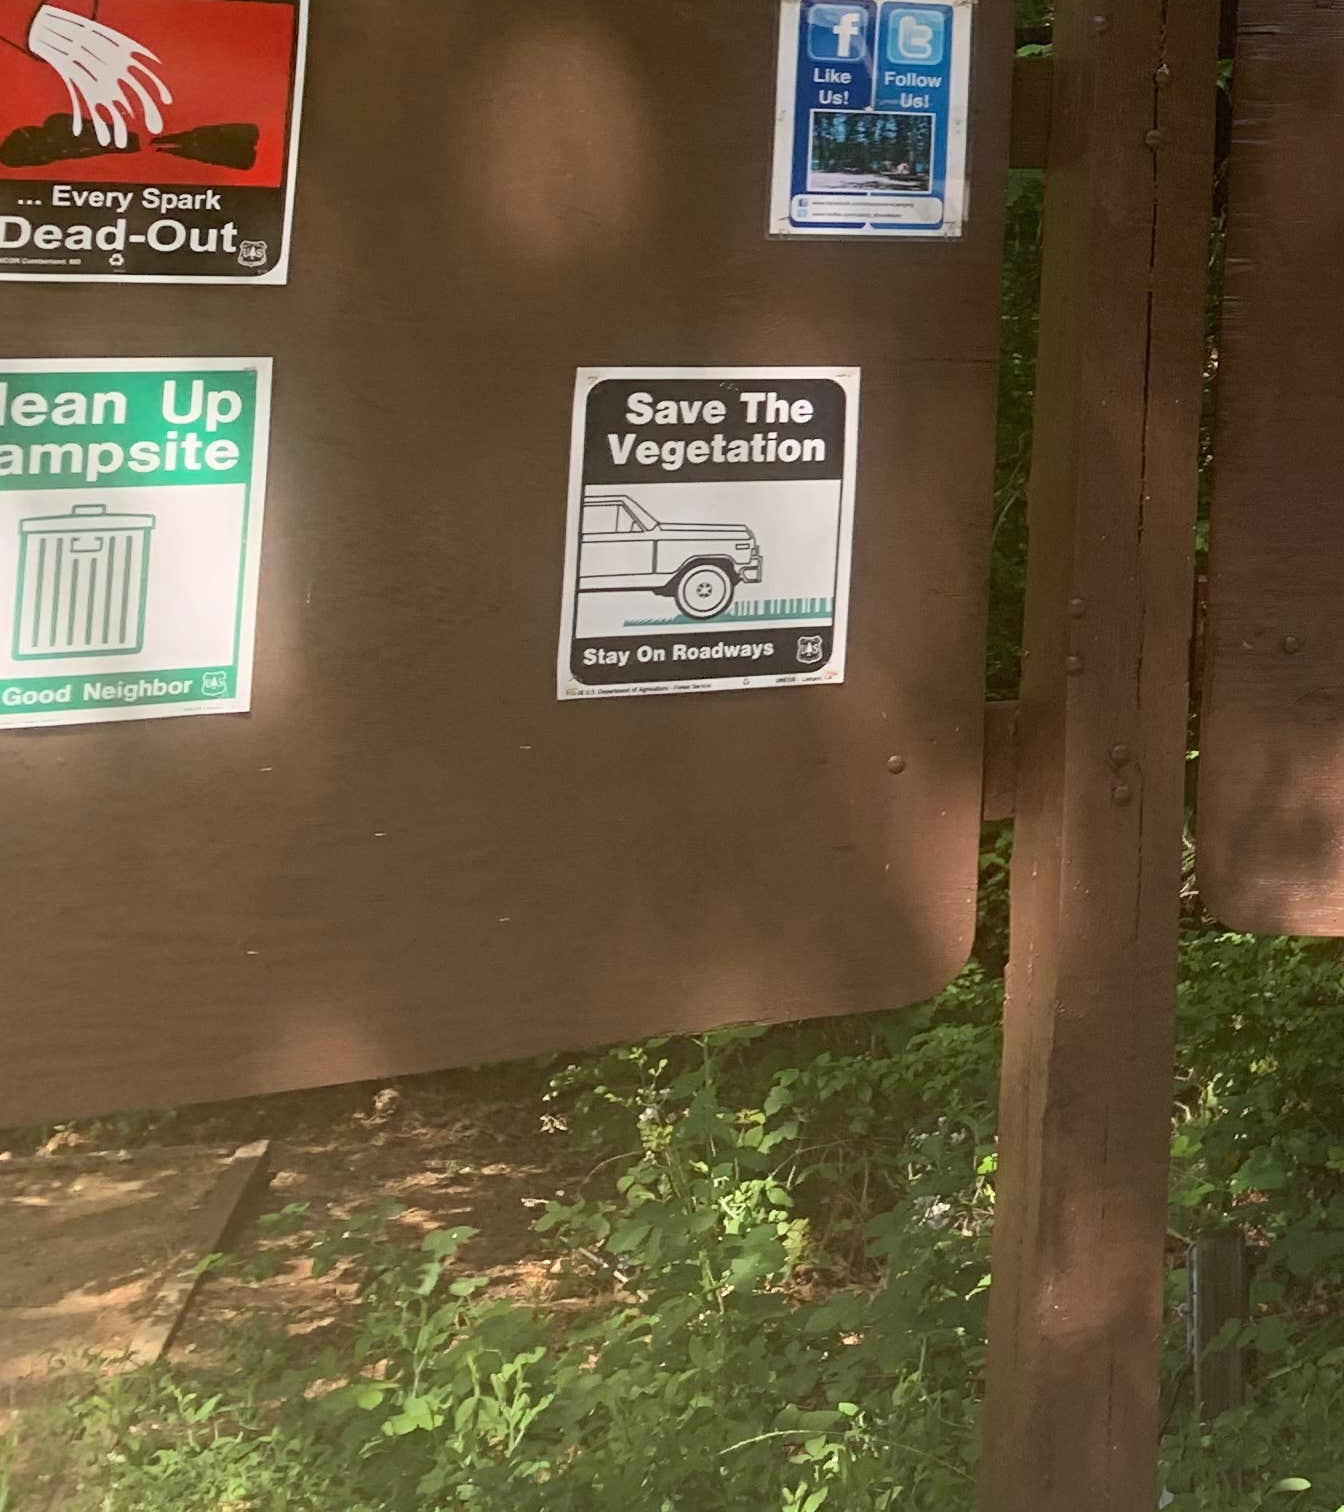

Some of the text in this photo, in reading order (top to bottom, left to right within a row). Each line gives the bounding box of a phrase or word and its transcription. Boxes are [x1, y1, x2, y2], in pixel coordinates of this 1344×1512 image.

[813, 68, 851, 84] Like
[884, 71, 942, 88] Follow
[819, 90, 849, 105] Us!
[900, 93, 929, 108] Us!
[52, 185, 133, 212] Every
[142, 188, 221, 213] Spark
[0, 215, 238, 253] Dead-Out
[162, 379, 242, 432] Up
[625, 391, 814, 425] Save The
[607, 431, 826, 471] Vegetation
[583, 640, 775, 667] Stay On Roadways
[2, 678, 193, 707] Good Neighbor
